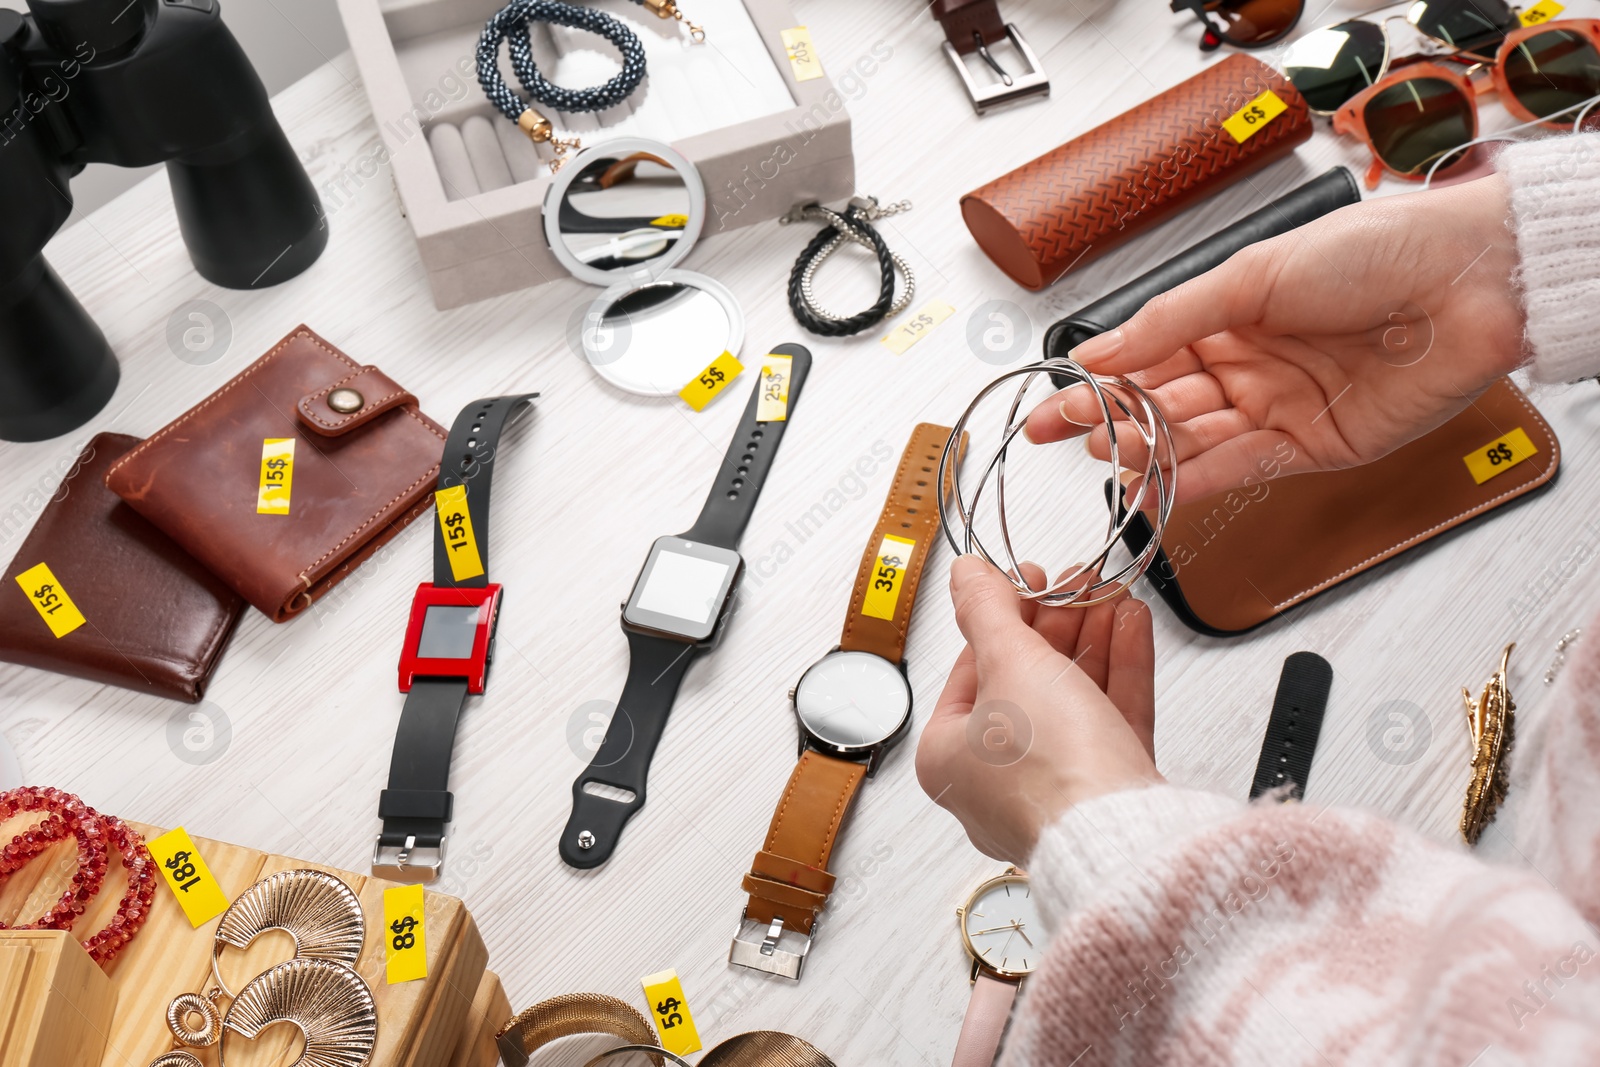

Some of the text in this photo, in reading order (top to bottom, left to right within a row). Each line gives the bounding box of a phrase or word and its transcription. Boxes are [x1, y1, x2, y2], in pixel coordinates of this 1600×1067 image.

[791, 41, 810, 65] 20$
[1242, 105, 1266, 125] 6$
[903, 314, 933, 335] 15$
[700, 367, 725, 389] 5$
[764, 373, 785, 401] 25$
[1487, 442, 1512, 465] 8$
[266, 458, 288, 490] 15$
[444, 512, 467, 552] 15$
[875, 555, 903, 592] 35$
[34, 584, 63, 615] 15$
[165, 851, 201, 893] 18$
[389, 915, 418, 950] 8$
[656, 997, 683, 1029] 5$
